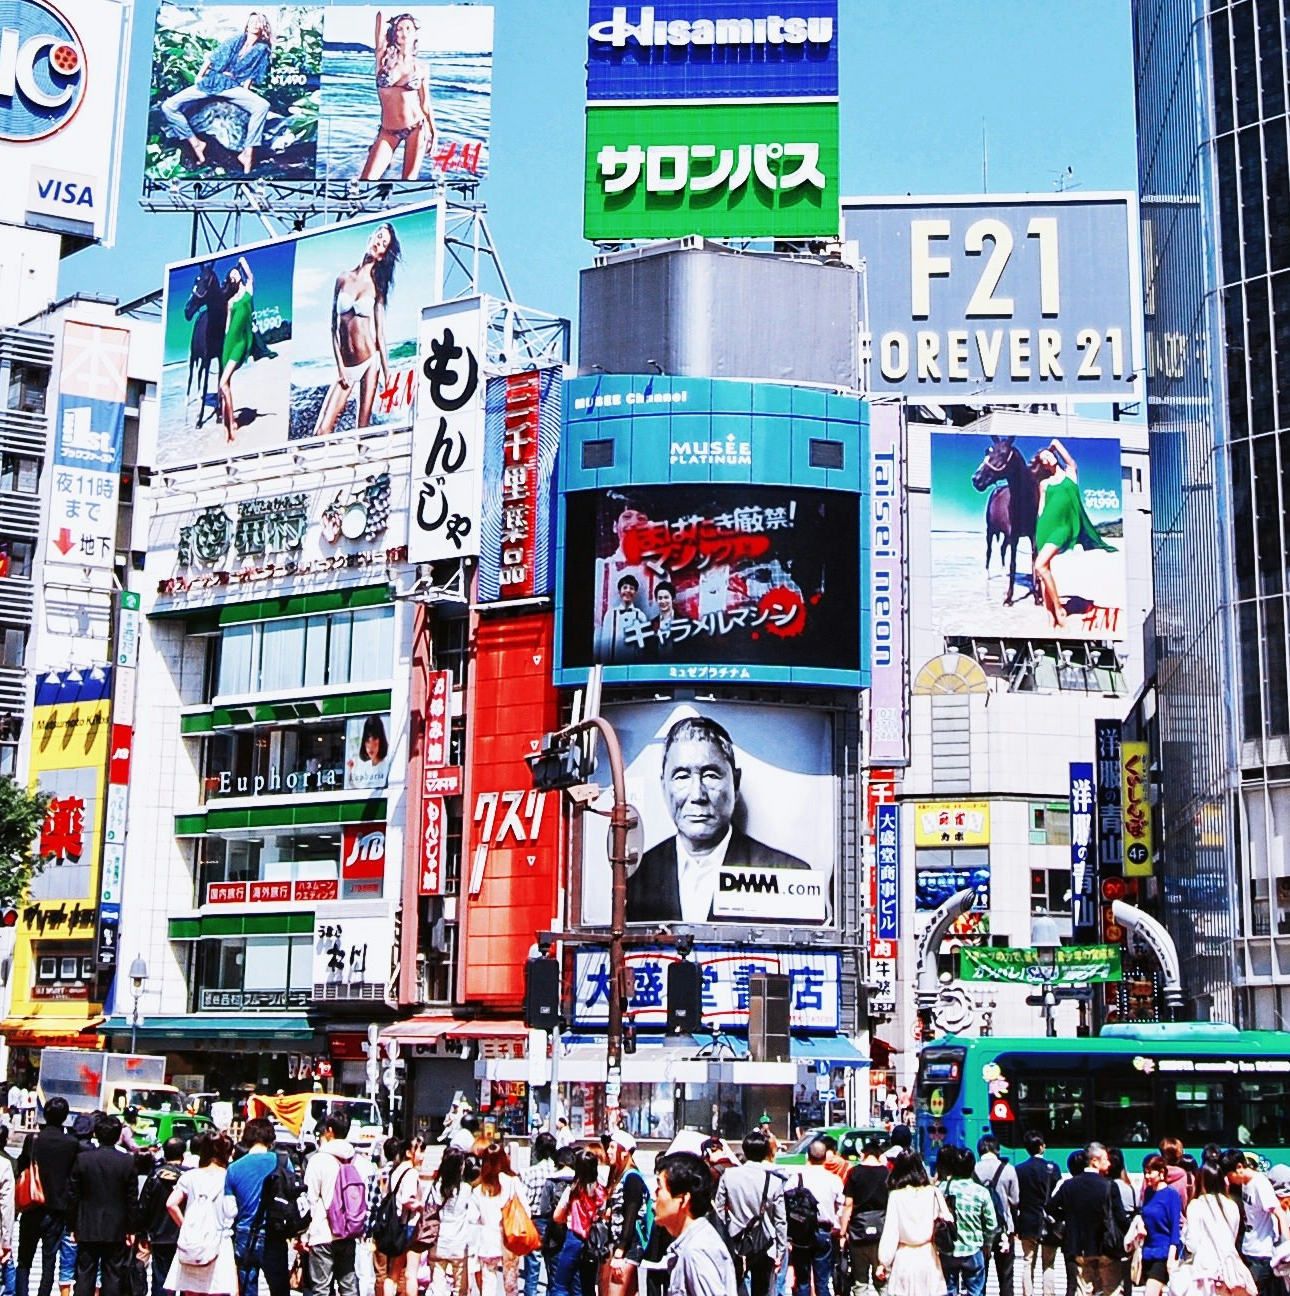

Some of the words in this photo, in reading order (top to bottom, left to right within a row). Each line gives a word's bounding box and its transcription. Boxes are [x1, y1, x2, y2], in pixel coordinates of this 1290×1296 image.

[588, 6, 834, 47] Hisamitsu
[597, 142, 826, 193] サロンパス
[37, 178, 95, 208] VISA
[910, 217, 1061, 318] F21
[1076, 328, 1123, 381] 21
[416, 327, 479, 549] もんじゃ
[670, 454, 752, 465] PLATINUM
[57, 471, 114, 499] 夜11時
[873, 442, 897, 560] Taisei
[65, 498, 101, 521] まで
[79, 532, 112, 557] 地下
[874, 570, 893, 667] neon
[218, 763, 337, 797] Euphoria
[345, 830, 386, 867] JTB
[1128, 846, 1146, 860] 4F
[879, 812, 896, 931] 大盛堂商事ビル
